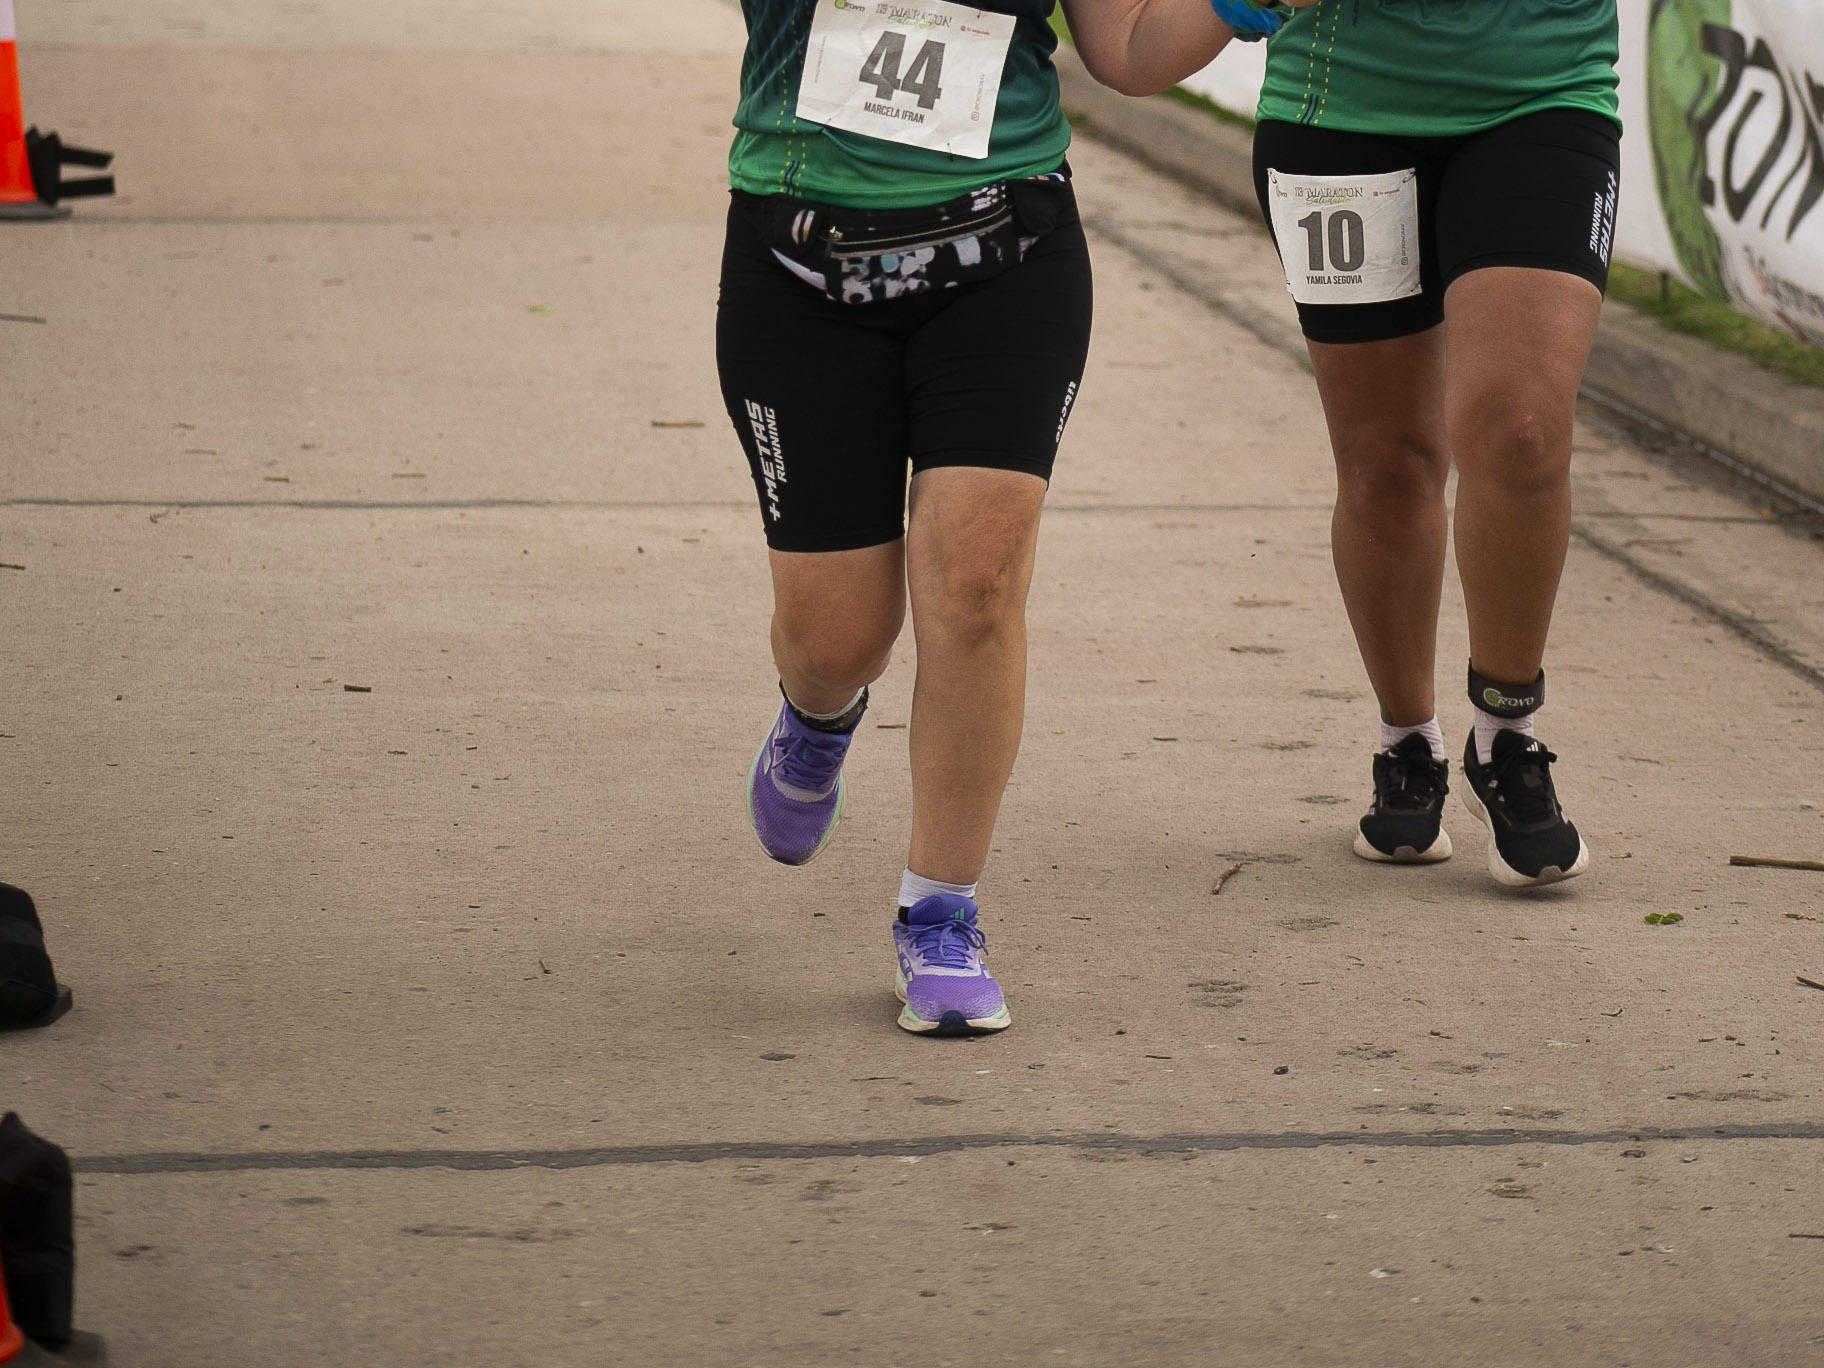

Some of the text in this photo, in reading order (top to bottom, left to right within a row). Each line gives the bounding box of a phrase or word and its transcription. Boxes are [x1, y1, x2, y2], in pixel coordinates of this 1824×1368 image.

[858, 30, 946, 110] 44
[864, 101, 925, 124] MARCELA IFRAN
[1298, 210, 1364, 271] 10
[1589, 192, 1603, 254] RUNNING
[1306, 274, 1363, 285] YAMILA SEGOVIA
[764, 407, 787, 483] RUNNING
